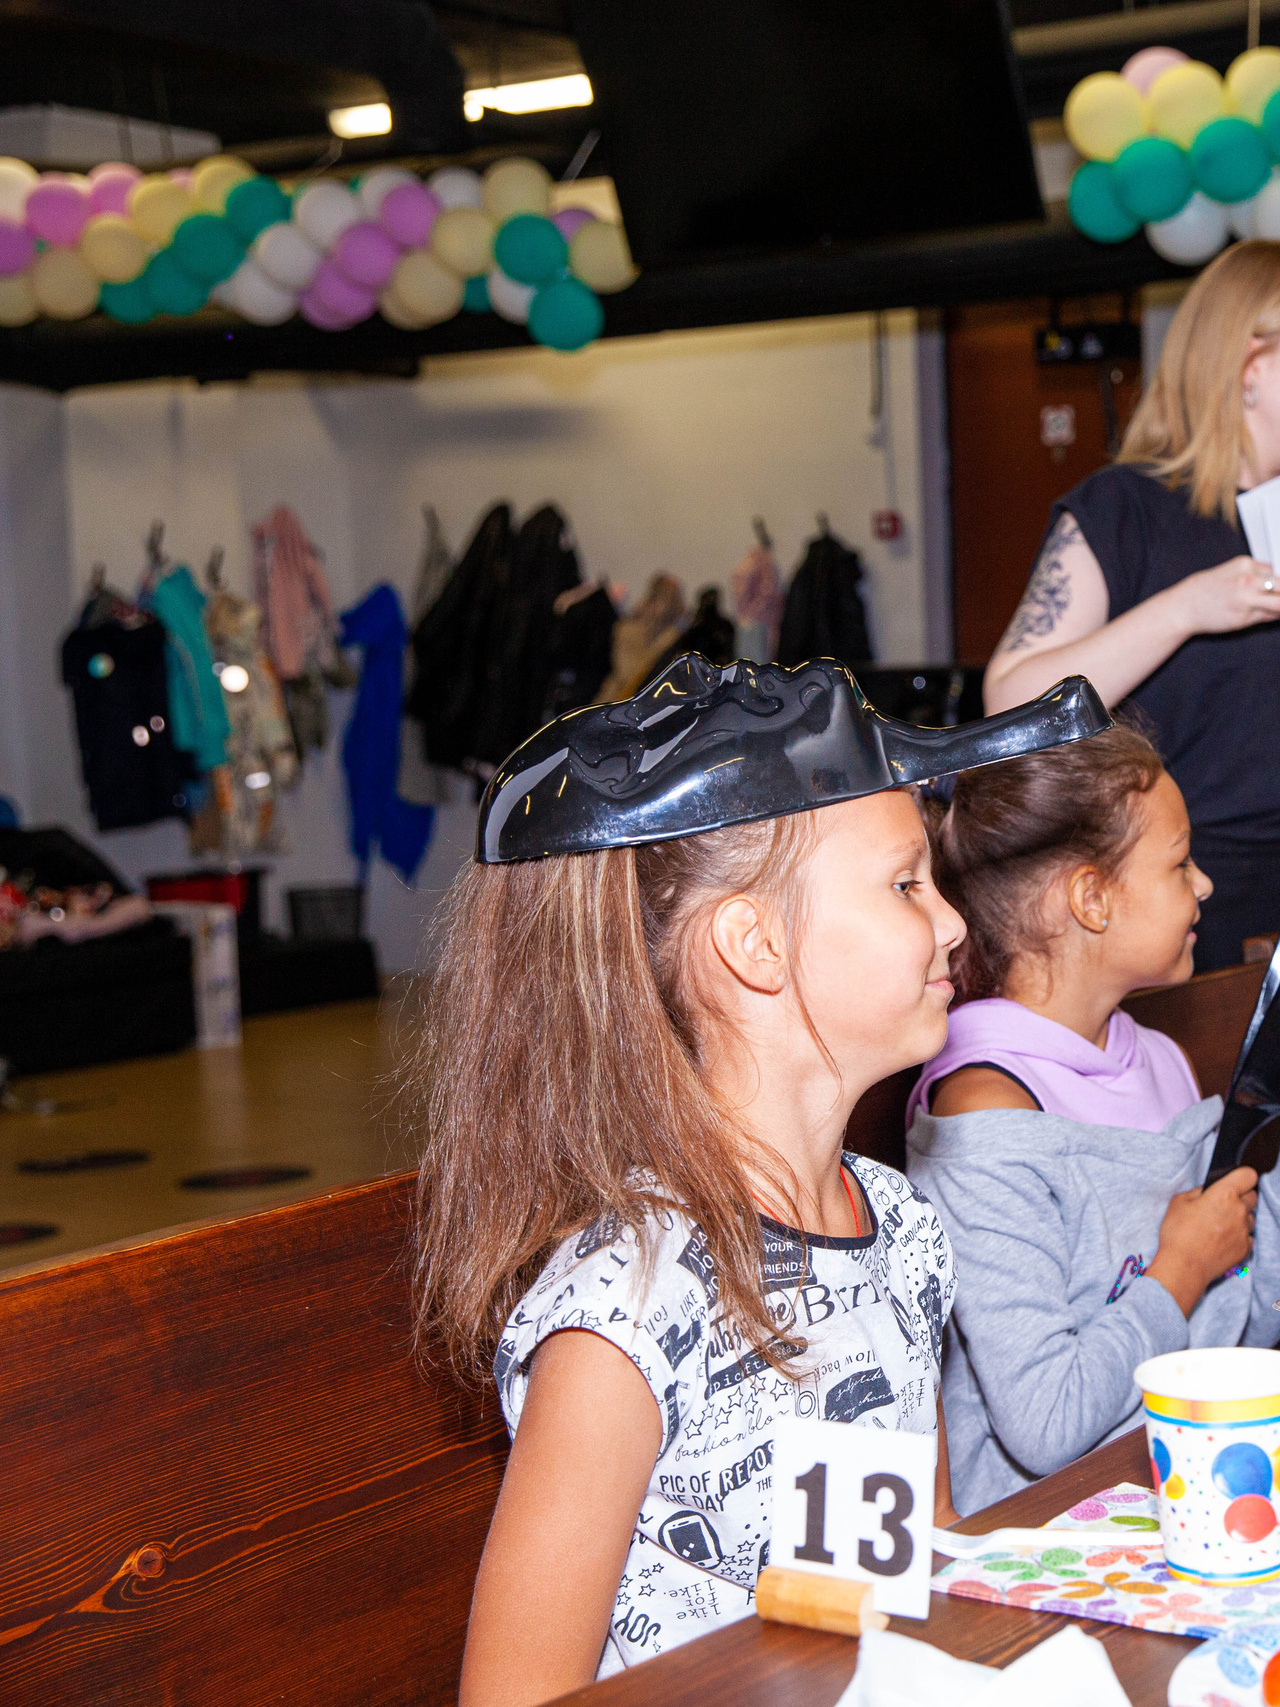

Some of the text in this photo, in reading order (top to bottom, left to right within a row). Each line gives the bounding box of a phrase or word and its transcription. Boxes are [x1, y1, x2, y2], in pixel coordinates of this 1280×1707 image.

[764, 1241, 794, 1253] YOUR
[763, 1261, 807, 1274] RIENDS
[679, 1288, 699, 1318] LIKE
[659, 1470, 711, 1493] PIC OF
[692, 1493, 725, 1513] DAY
[794, 1462, 915, 1577] 13
[685, 1592, 718, 1607] for
[676, 1603, 721, 1620] like
